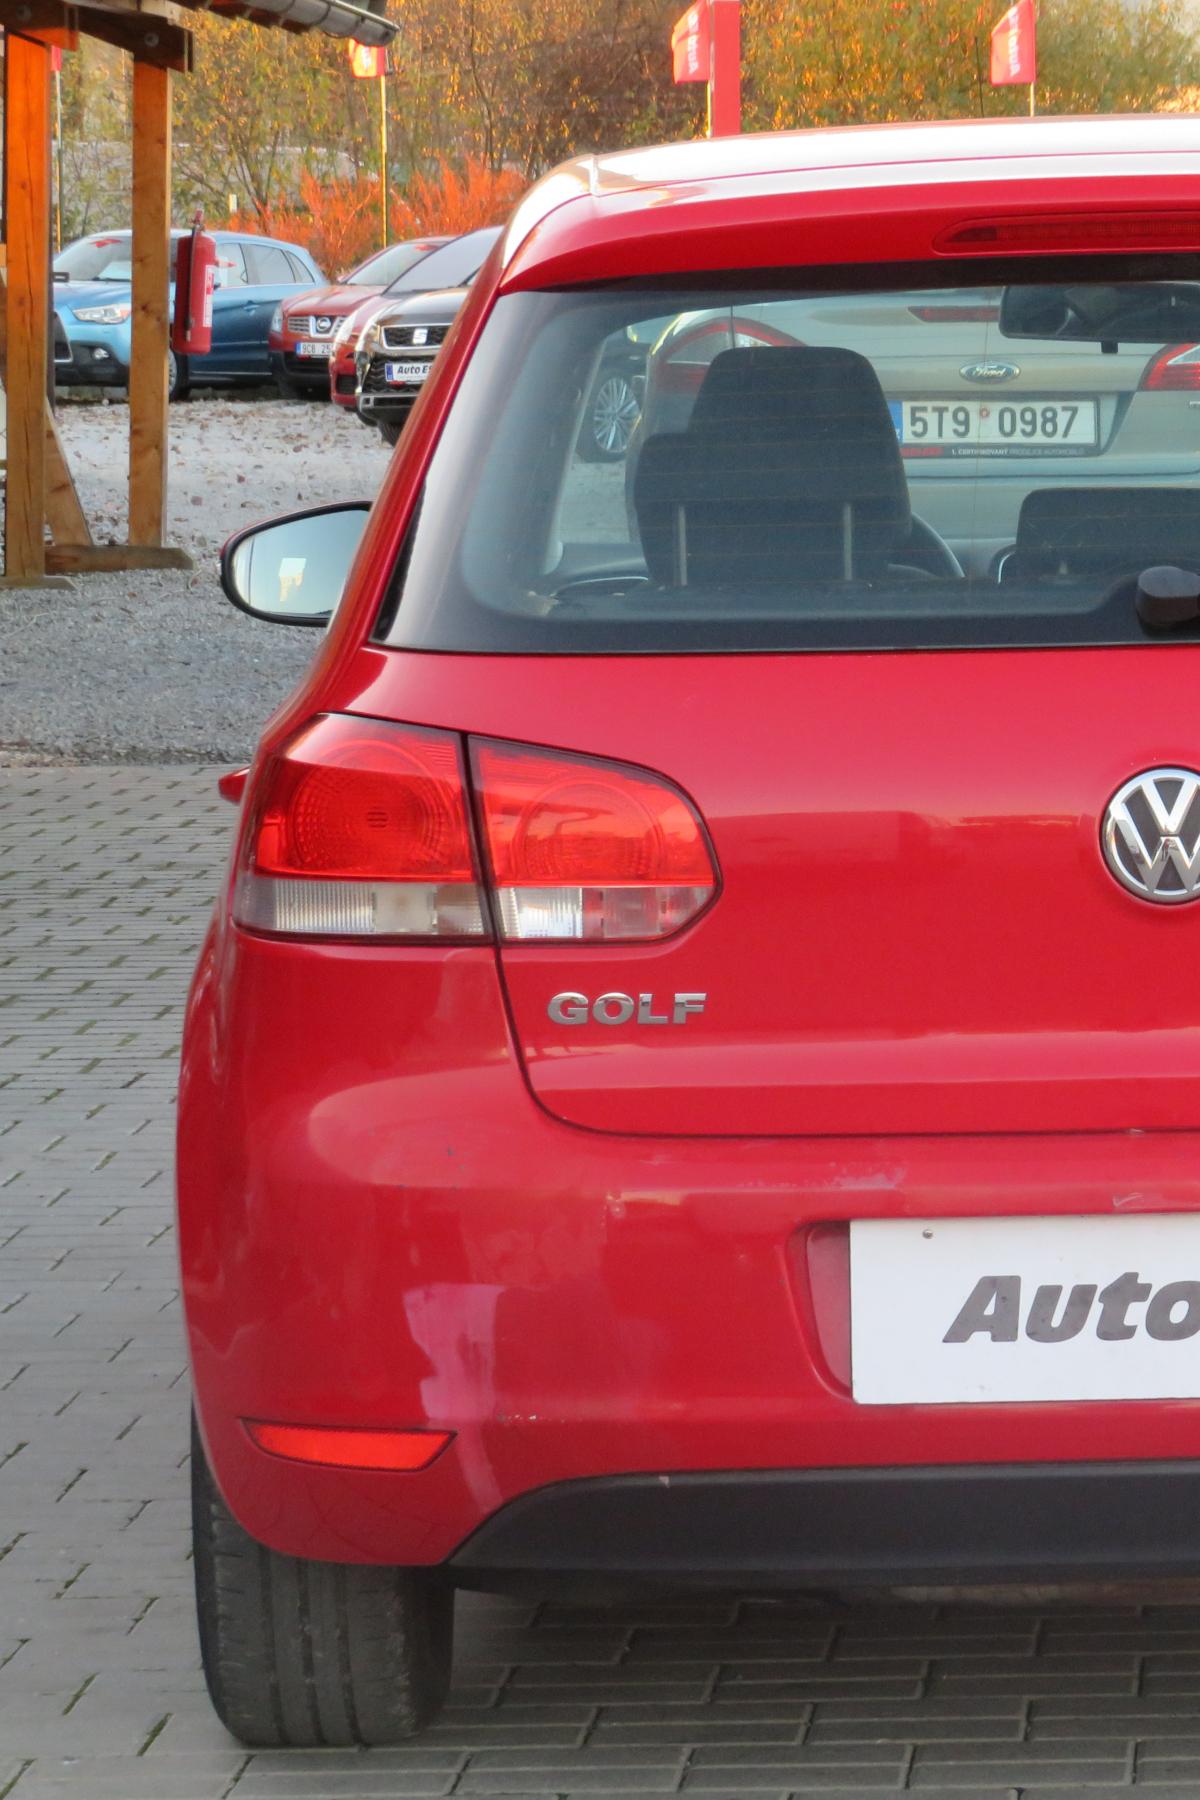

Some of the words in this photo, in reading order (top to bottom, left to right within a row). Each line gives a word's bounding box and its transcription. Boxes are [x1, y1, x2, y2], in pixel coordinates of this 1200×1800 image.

[397, 366, 421, 374] Auto
[910, 405, 970, 438] 5T9
[998, 405, 1079, 438] 0987
[547, 991, 707, 1025] GOLF
